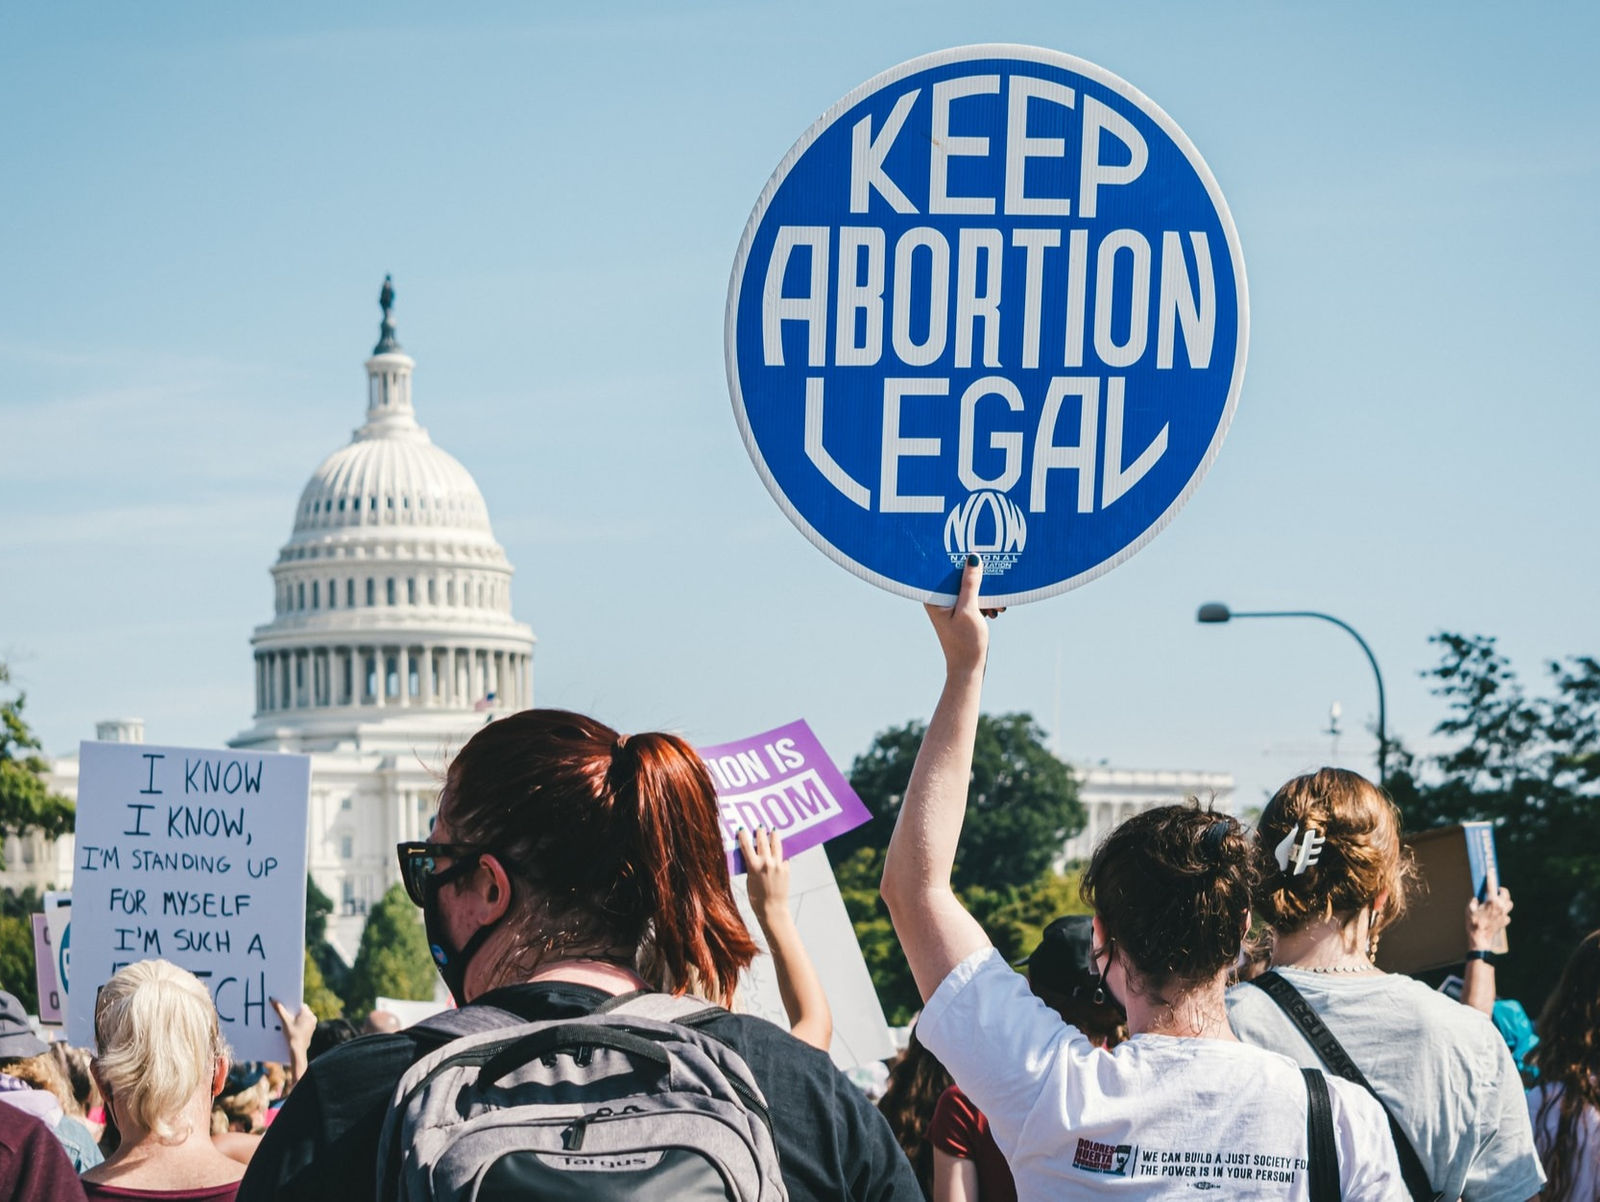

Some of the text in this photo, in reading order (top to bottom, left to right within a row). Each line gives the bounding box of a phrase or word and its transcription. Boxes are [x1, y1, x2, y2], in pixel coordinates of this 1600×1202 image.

[849, 74, 1149, 218] KEEP
[762, 226, 1217, 369] ABORTION
[804, 376, 1170, 513] LEGAL
[943, 491, 1027, 553] NOW
[950, 554, 1018, 562] NAONAL
[139, 753, 263, 794] I KNOW
[703, 737, 805, 789] ION IS
[123, 804, 252, 846] I KNOW,
[81, 846, 278, 879] I'M STANDING UP
[110, 888, 251, 917] FOR MYSELF
[114, 926, 265, 959] I'M SUCH A
[1077, 1137, 1116, 1154] DOLORES
[1142, 1150, 1159, 1162] WE
[1161, 1152, 1181, 1163] CAN
[1185, 1151, 1212, 1164] BUILD
[1215, 1153, 1222, 1164] A
[1225, 1153, 1251, 1165] JUST
[1253, 1154, 1292, 1169] SOCIETY
[1140, 1164, 1295, 1184] THE POWER IS IN YOUR PERSON!
